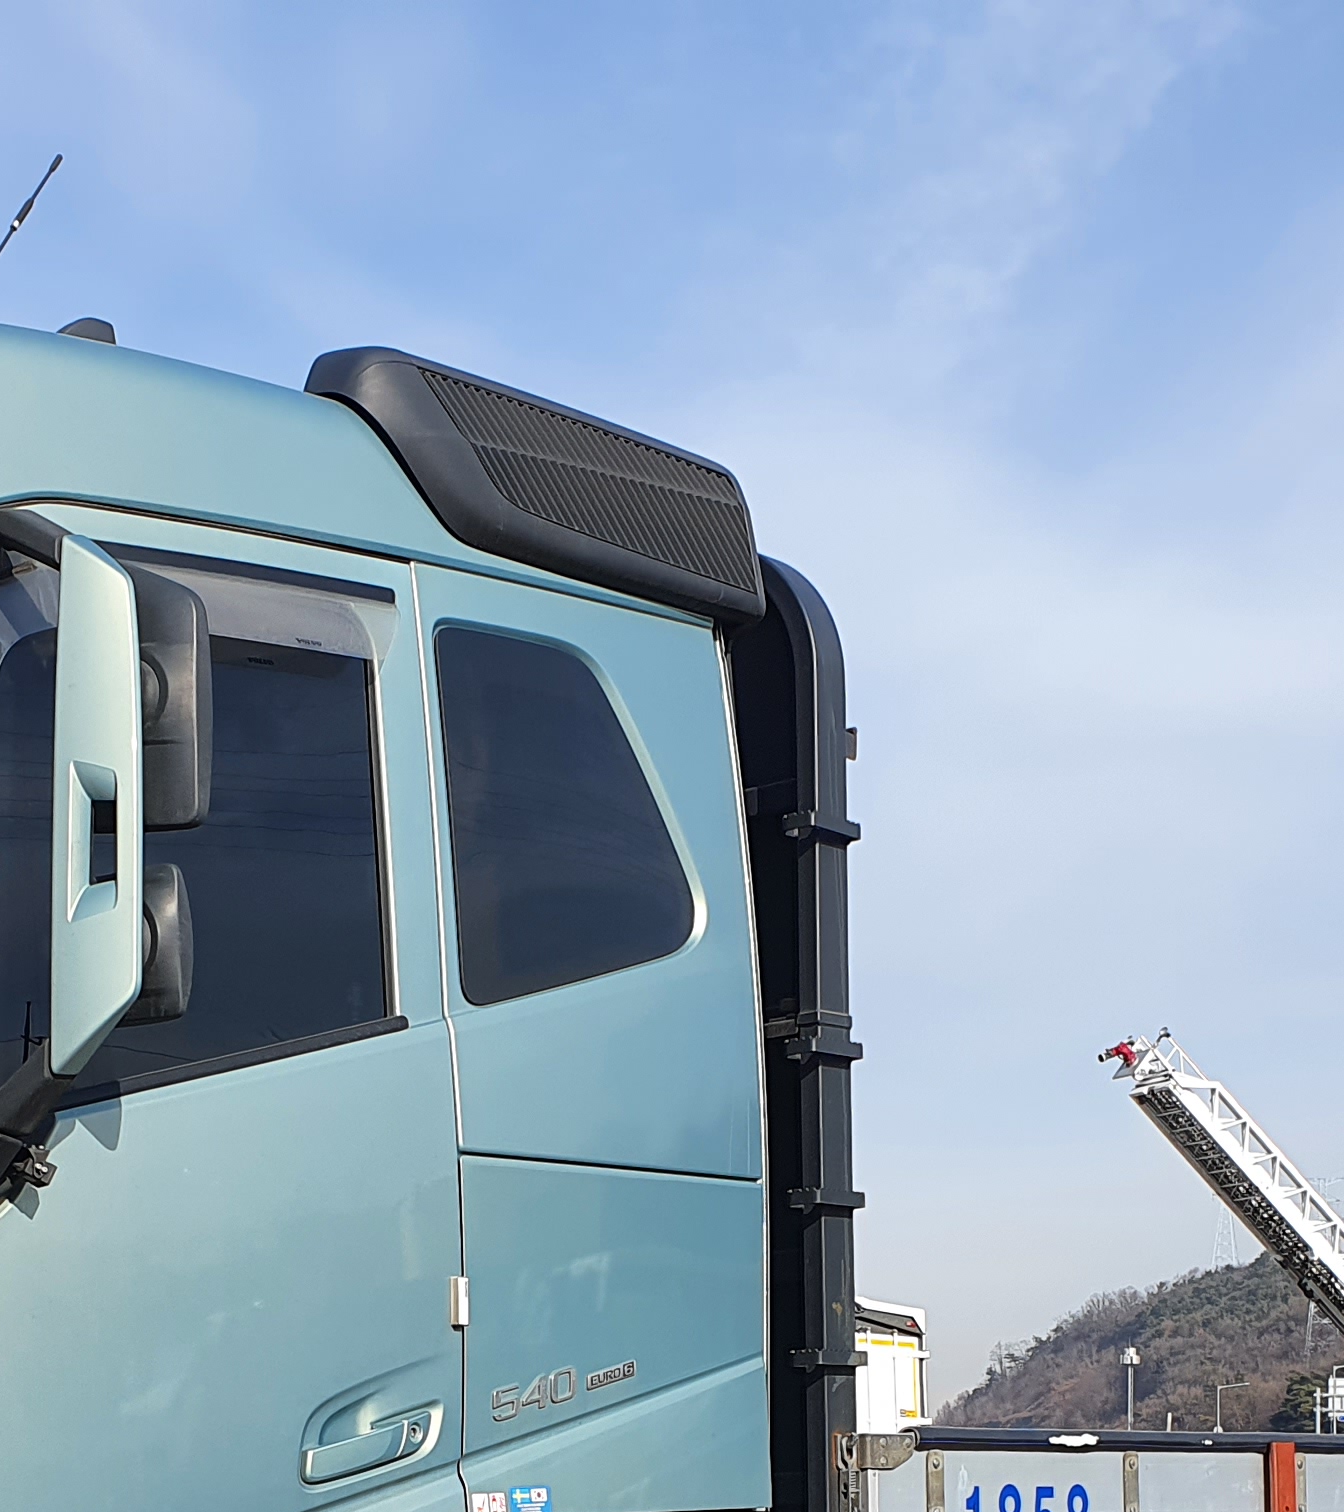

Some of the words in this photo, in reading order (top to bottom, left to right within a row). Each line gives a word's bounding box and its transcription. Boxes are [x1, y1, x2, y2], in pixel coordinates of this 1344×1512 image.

[491, 1367, 577, 1422] 540
[589, 1367, 622, 1387] EURO
[622, 1361, 635, 1378] 6
